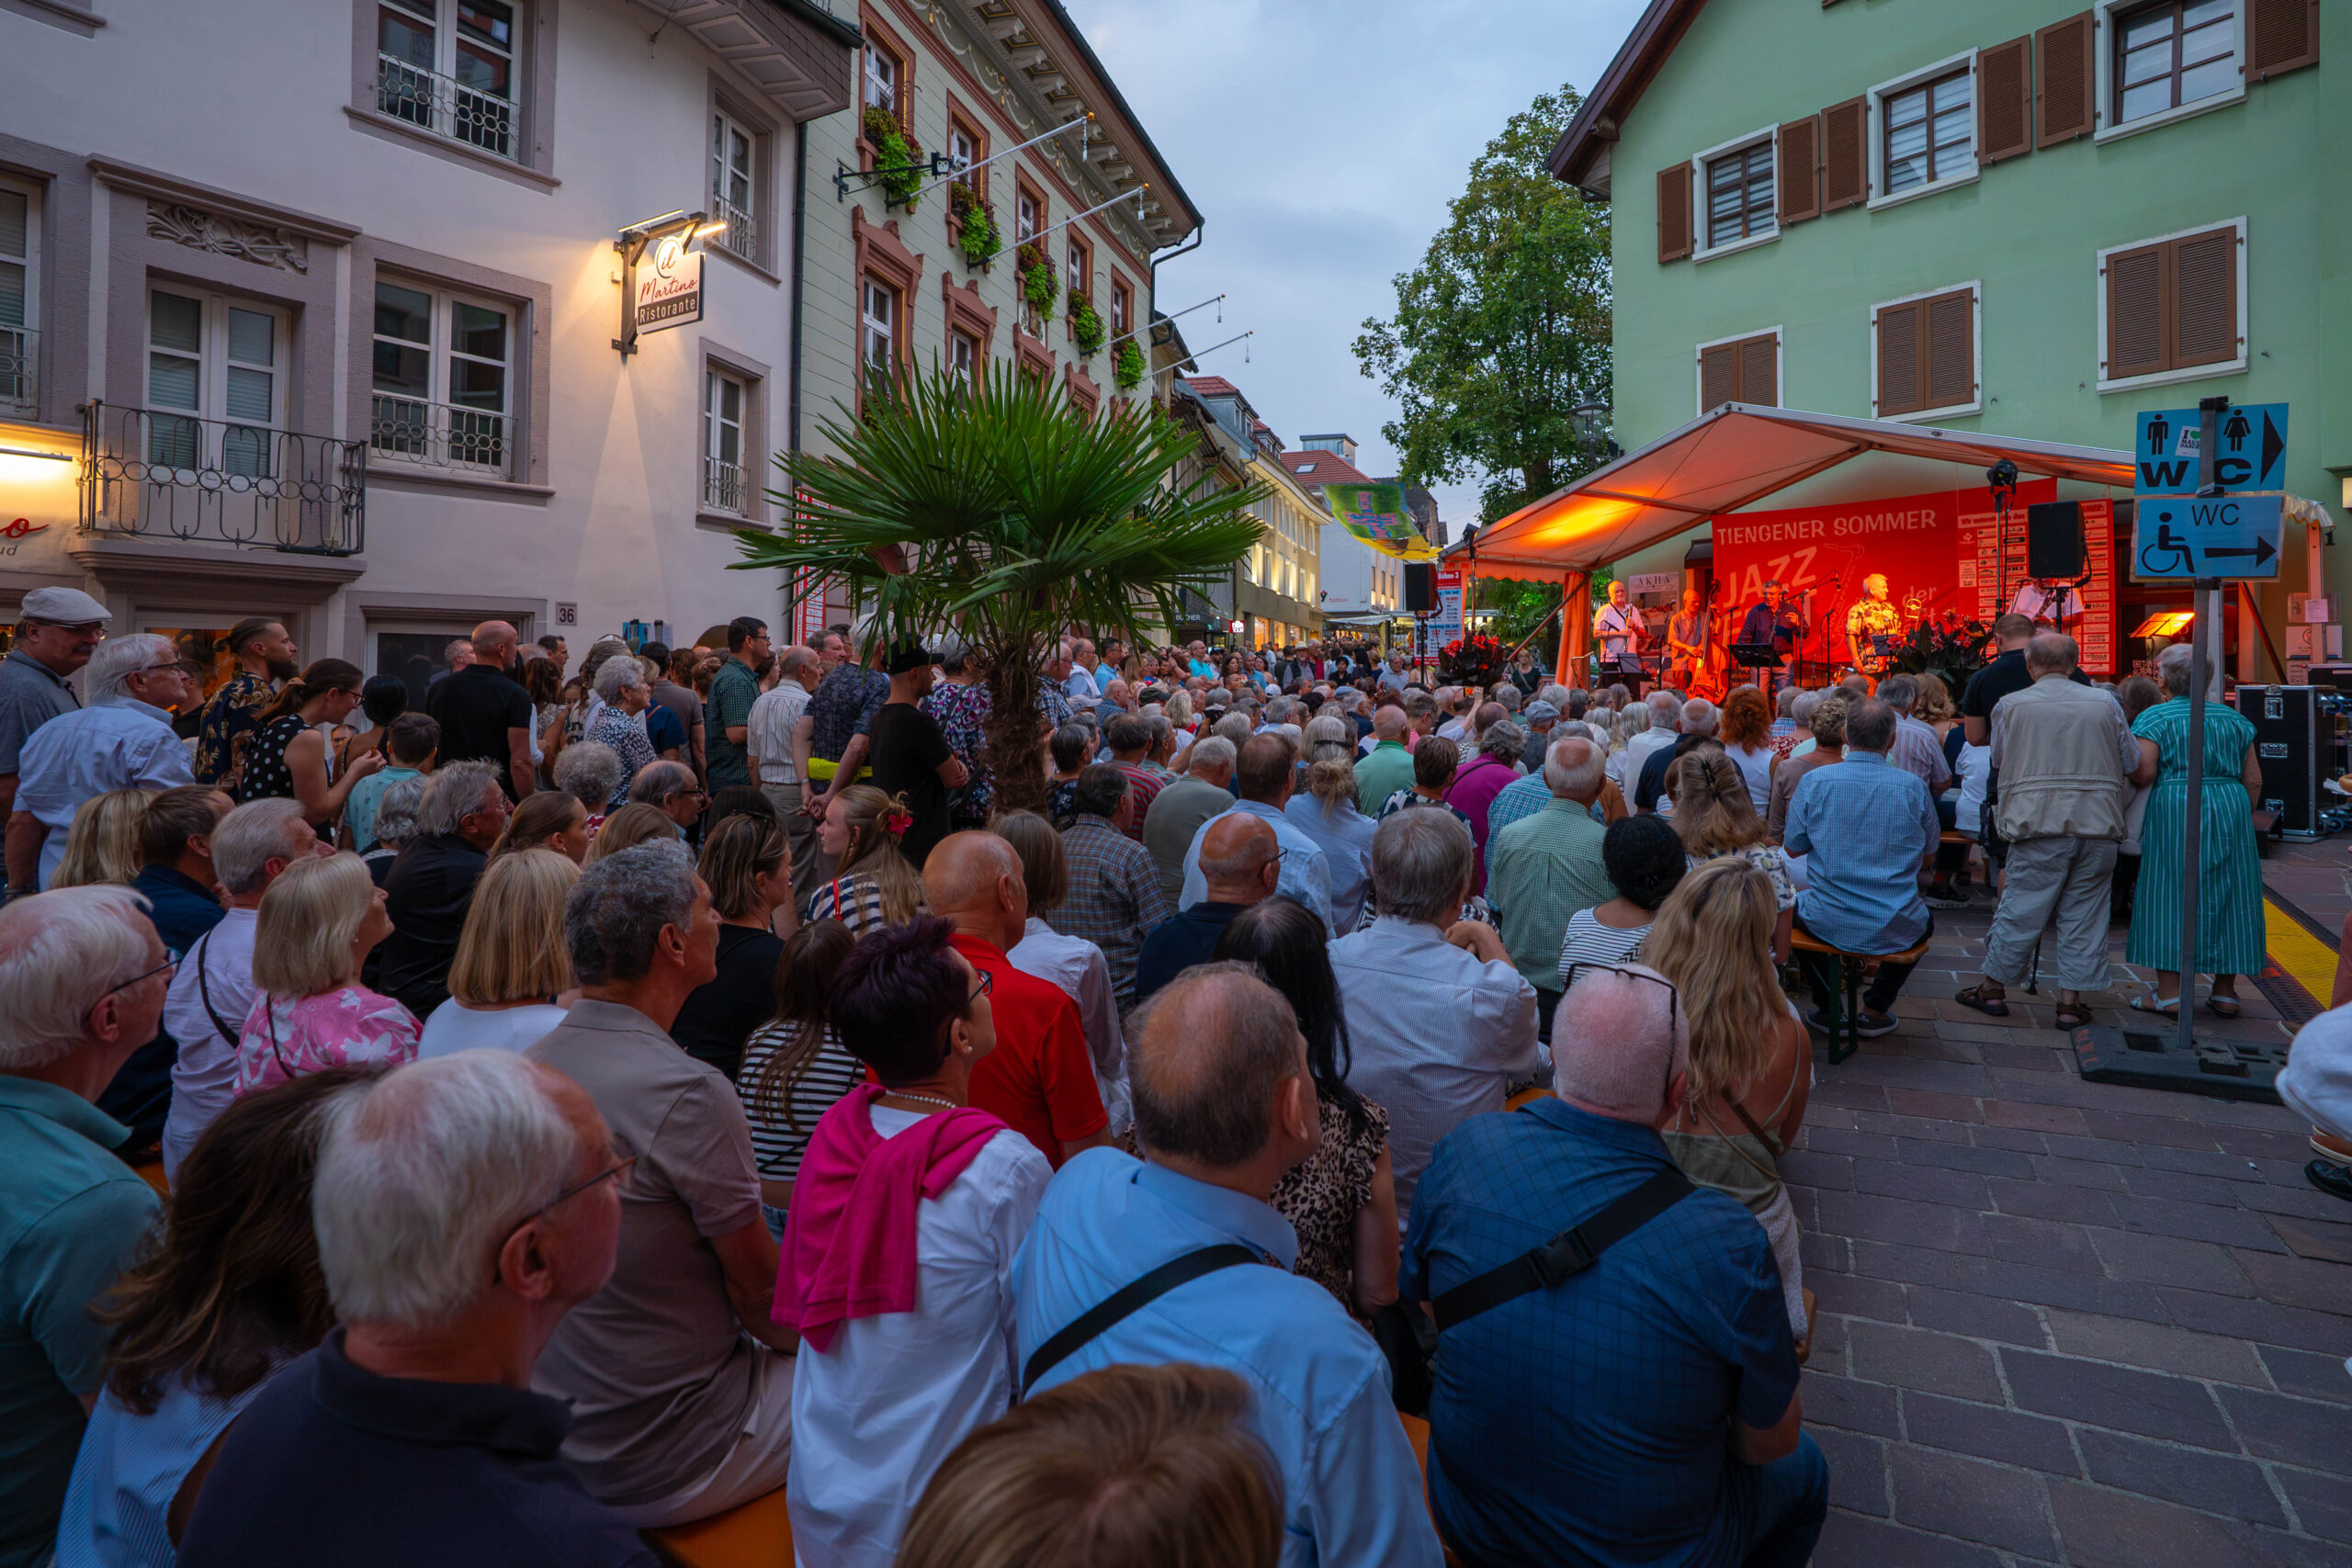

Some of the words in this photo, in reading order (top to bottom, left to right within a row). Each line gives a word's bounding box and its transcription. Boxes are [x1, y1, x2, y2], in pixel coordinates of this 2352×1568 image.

[661, 246, 676, 270] il
[640, 277, 698, 303] Martino
[639, 298, 696, 324] Ristorante
[2191, 503, 2240, 526] WC
[1717, 520, 1826, 546] TIENGENER
[1833, 509, 1937, 536] SOMMER
[2324, 531, 2335, 546] 1
[1722, 546, 1817, 608] JAZZ
[1902, 585, 1938, 608] der
[559, 608, 575, 624] 36
